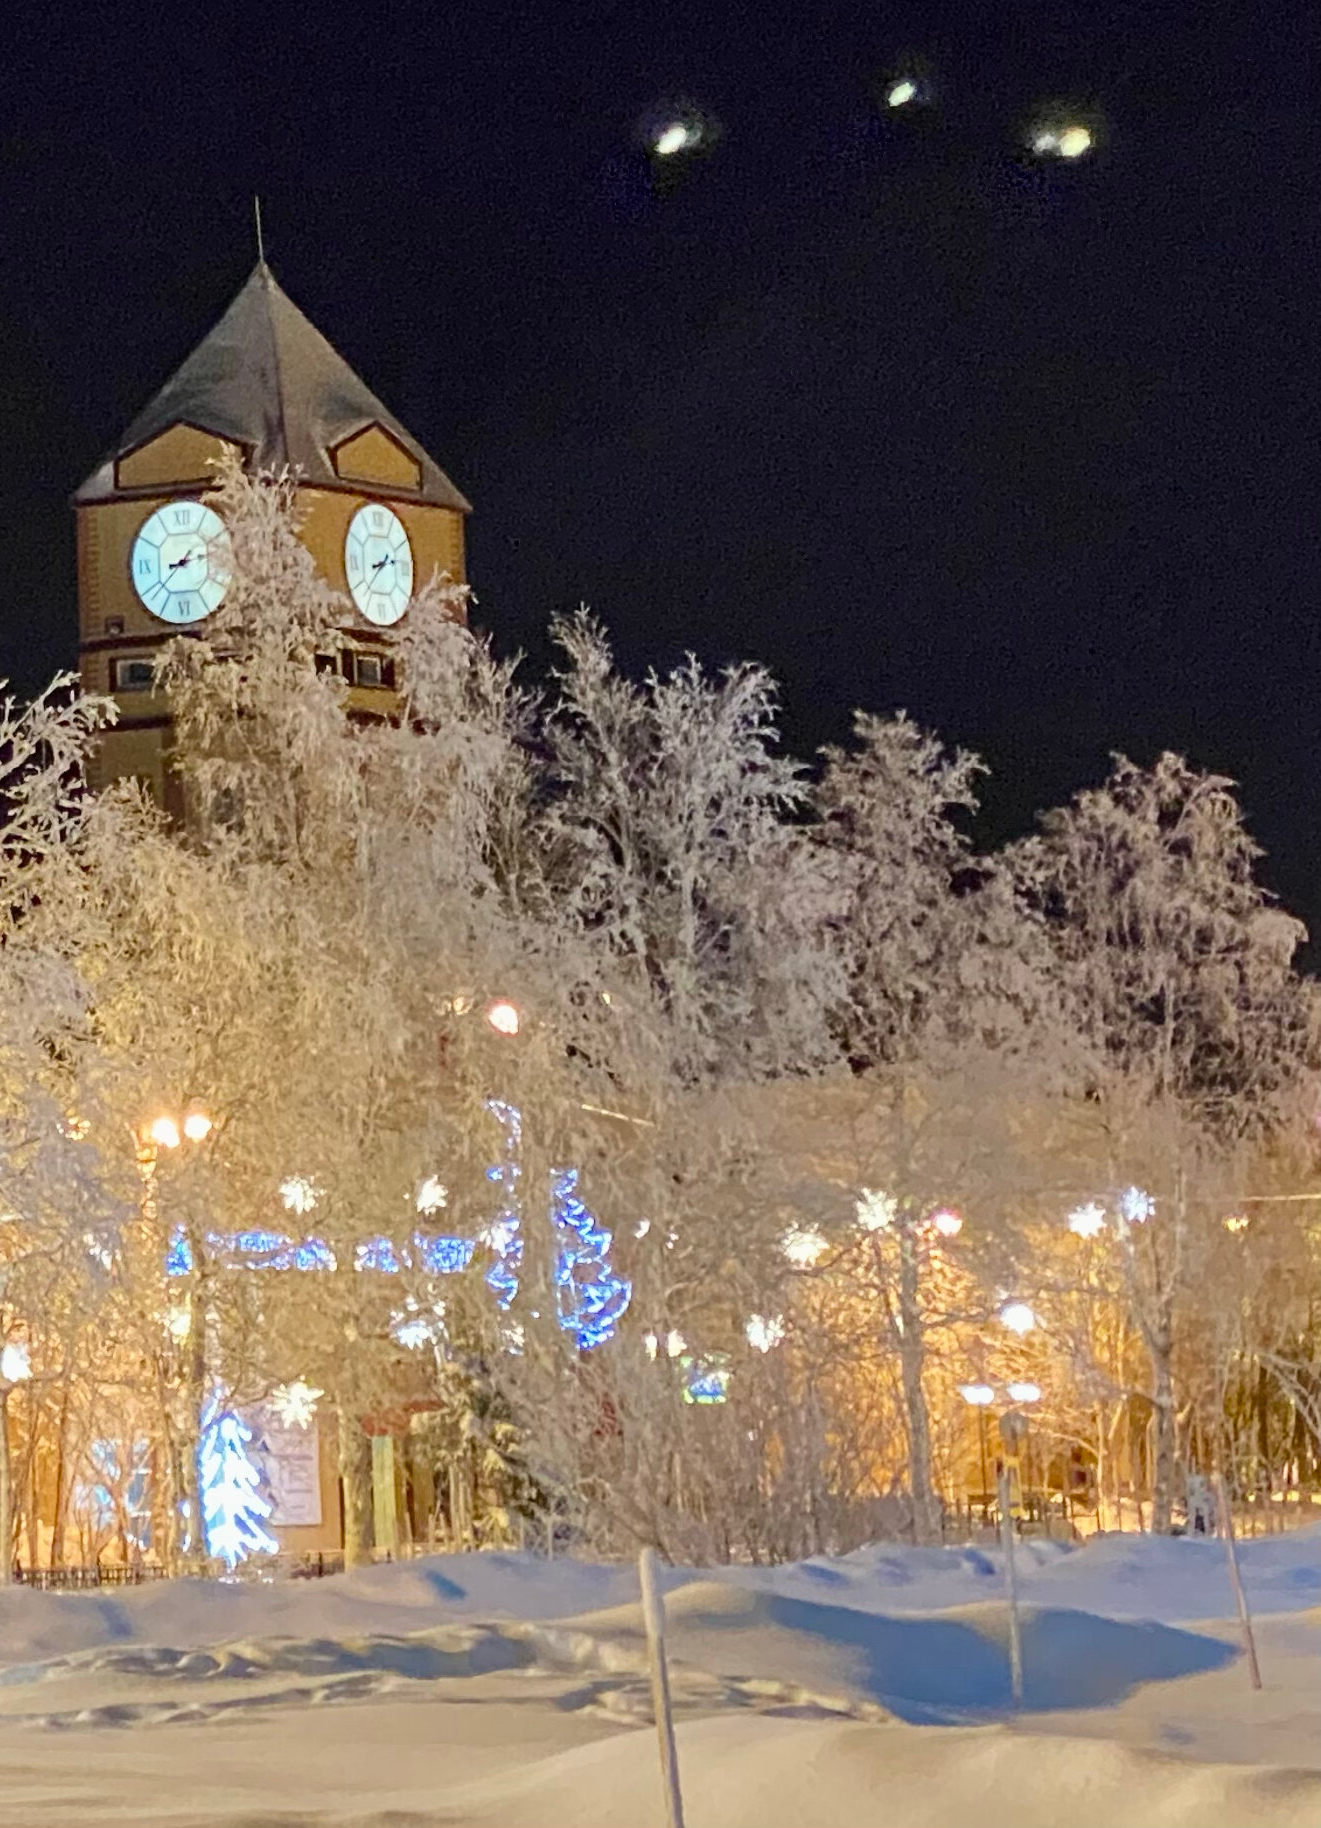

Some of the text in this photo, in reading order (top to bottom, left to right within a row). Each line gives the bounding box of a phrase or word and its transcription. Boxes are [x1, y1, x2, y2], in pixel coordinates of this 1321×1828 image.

[174, 509, 191, 526] XII
[139, 559, 152, 574] IX
[177, 601, 191, 616] VI
